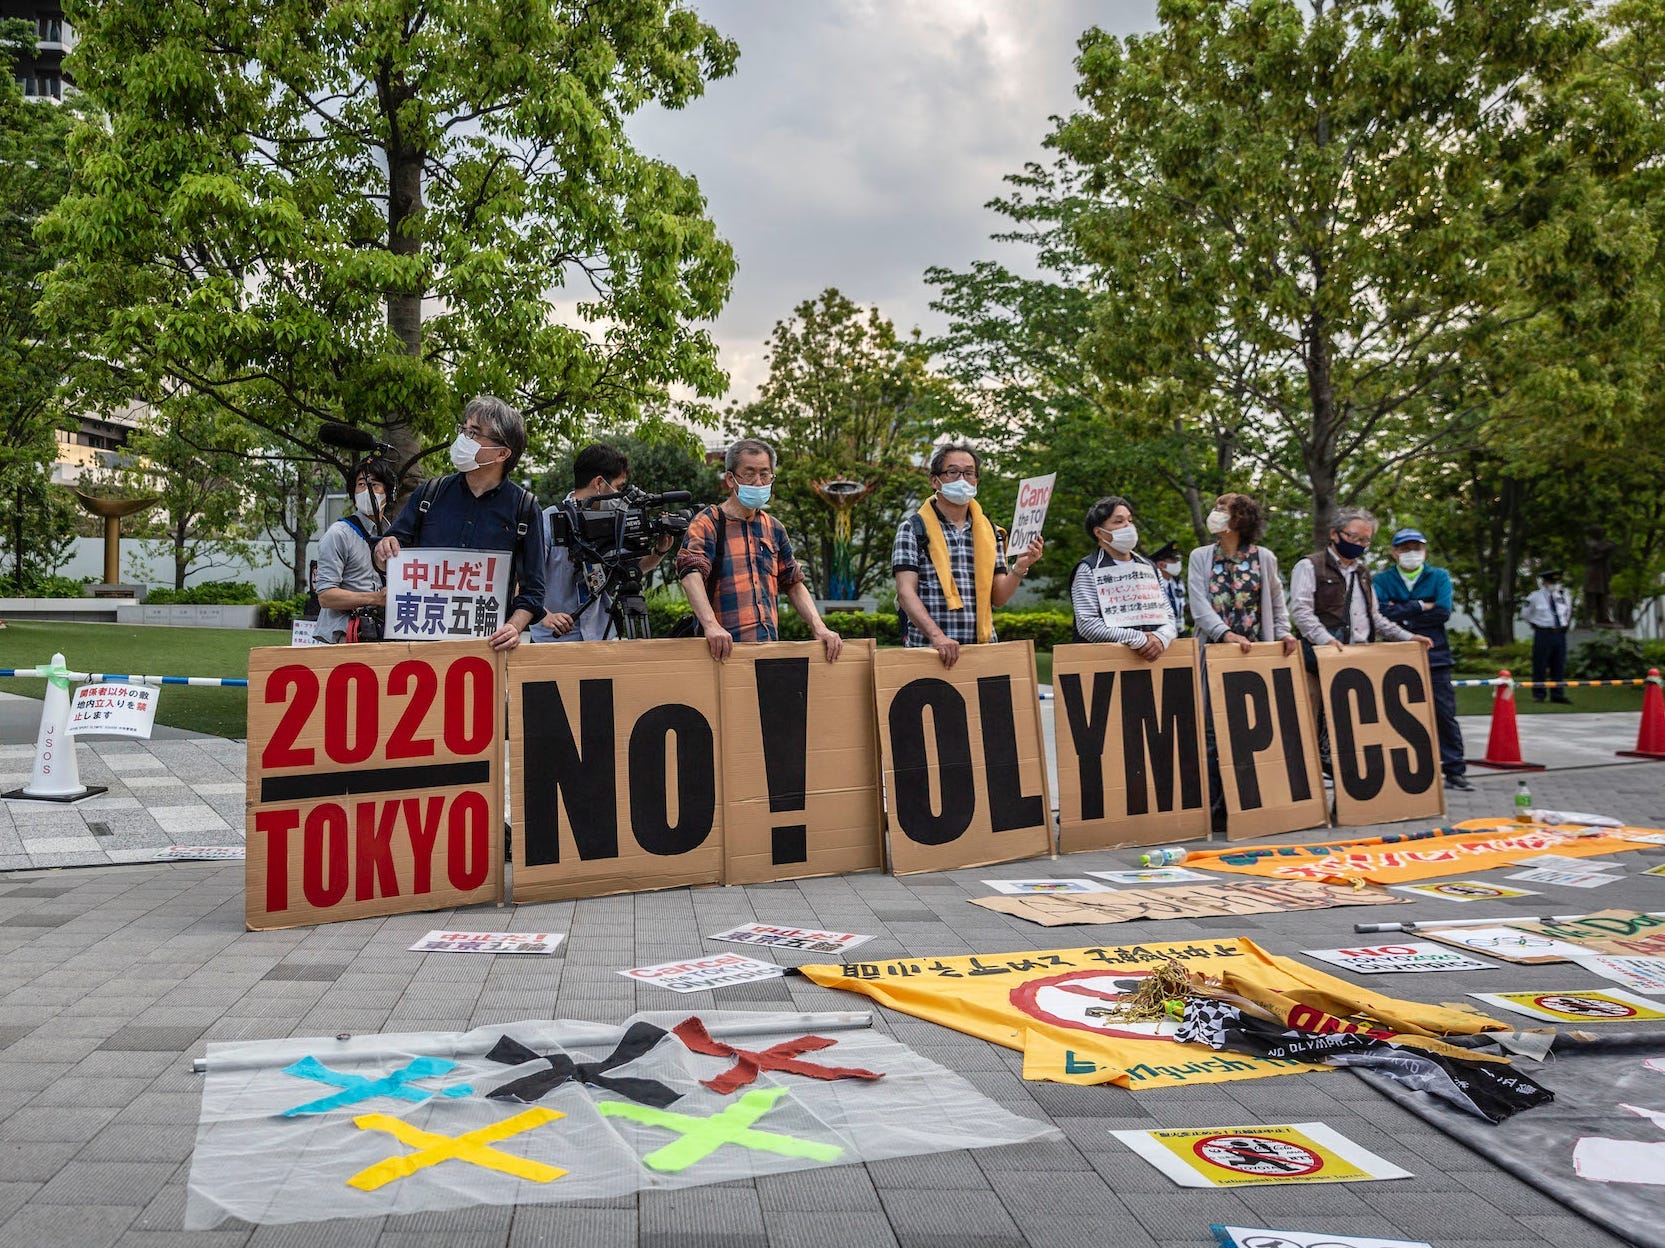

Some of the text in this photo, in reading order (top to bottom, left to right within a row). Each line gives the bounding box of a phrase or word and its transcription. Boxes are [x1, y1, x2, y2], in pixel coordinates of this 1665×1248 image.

[1018, 513, 1029, 526] the
[402, 557, 497, 592] 中止だ!
[393, 591, 500, 637] 東京五輪
[79, 687, 150, 701] 関係者以外の敷
[76, 699, 147, 712] 地内立入りを禁
[261, 655, 494, 770] 2020
[73, 711, 113, 722] 止します
[255, 790, 490, 914] TOKYO
[440, 932, 548, 943] 中止だ!
[719, 931, 844, 951] 東京五輪
[751, 926, 855, 943] 中止だ!
[419, 941, 548, 951] 東京五輪
[1338, 946, 1418, 957] NO
[629, 954, 749, 978] Cancel
[659, 962, 759, 984] the TOKYO
[1355, 960, 1483, 971] Olympics
[667, 966, 780, 991] Olympics
